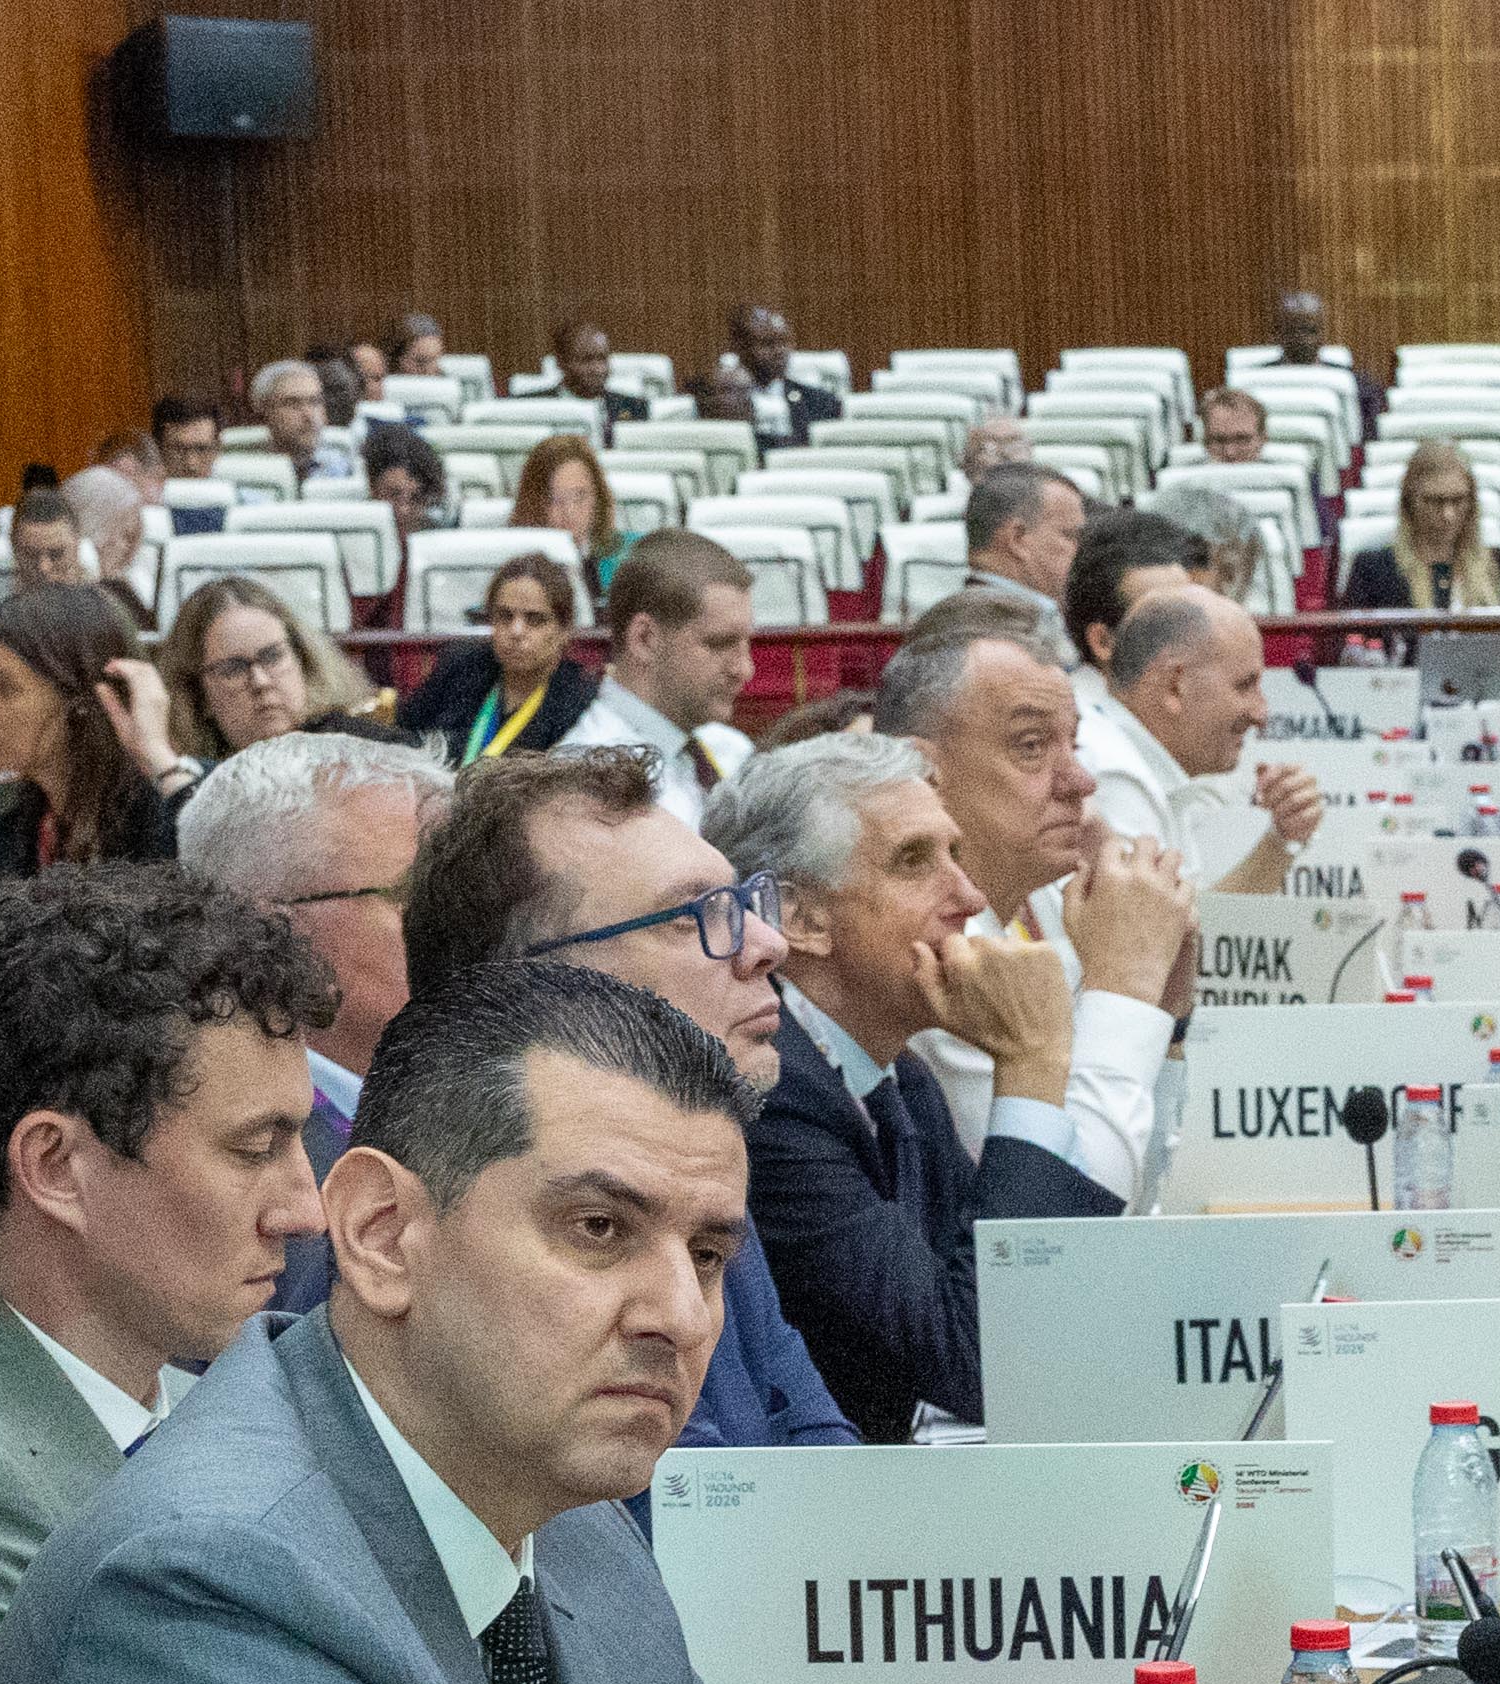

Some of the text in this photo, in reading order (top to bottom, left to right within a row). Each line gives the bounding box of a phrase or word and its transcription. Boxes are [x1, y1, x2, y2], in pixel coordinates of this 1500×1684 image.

[1198, 934, 1293, 982] LOVAK
[1174, 1317, 1284, 1384] ITAL
[804, 1575, 1174, 1664] LITHUANIA
